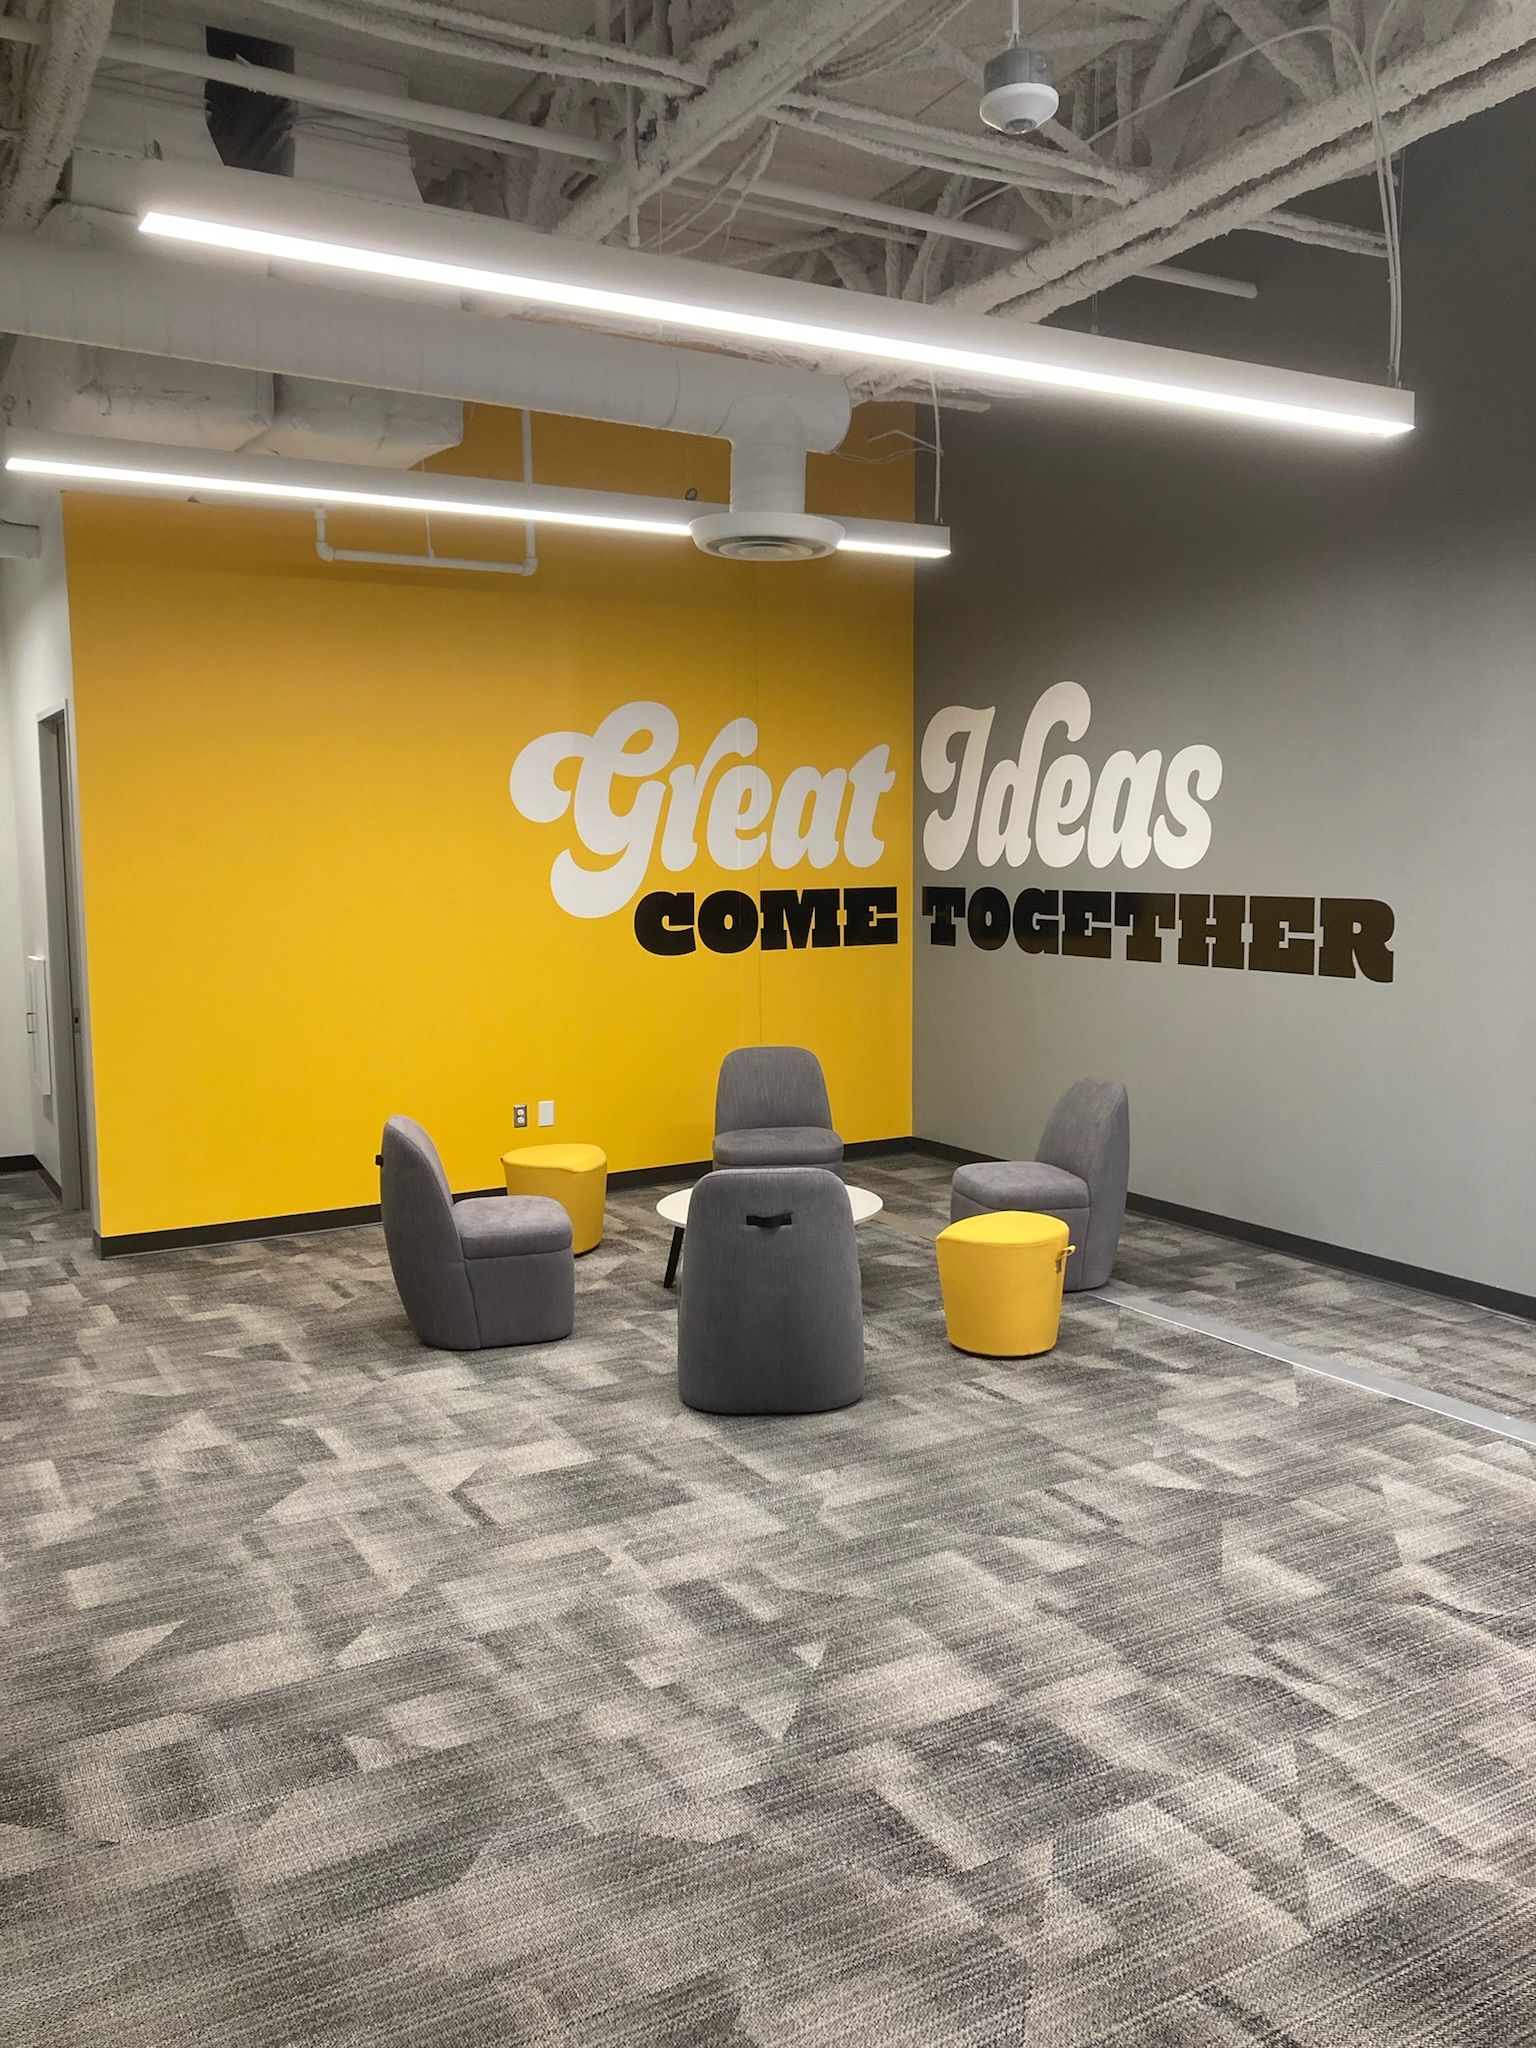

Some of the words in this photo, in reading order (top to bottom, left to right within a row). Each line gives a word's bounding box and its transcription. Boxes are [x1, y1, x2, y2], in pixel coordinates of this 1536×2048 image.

[509, 700, 896, 919] Great
[920, 680, 1223, 871] Ideas
[633, 886, 898, 956] COME
[922, 886, 1395, 984] TOGETHER
